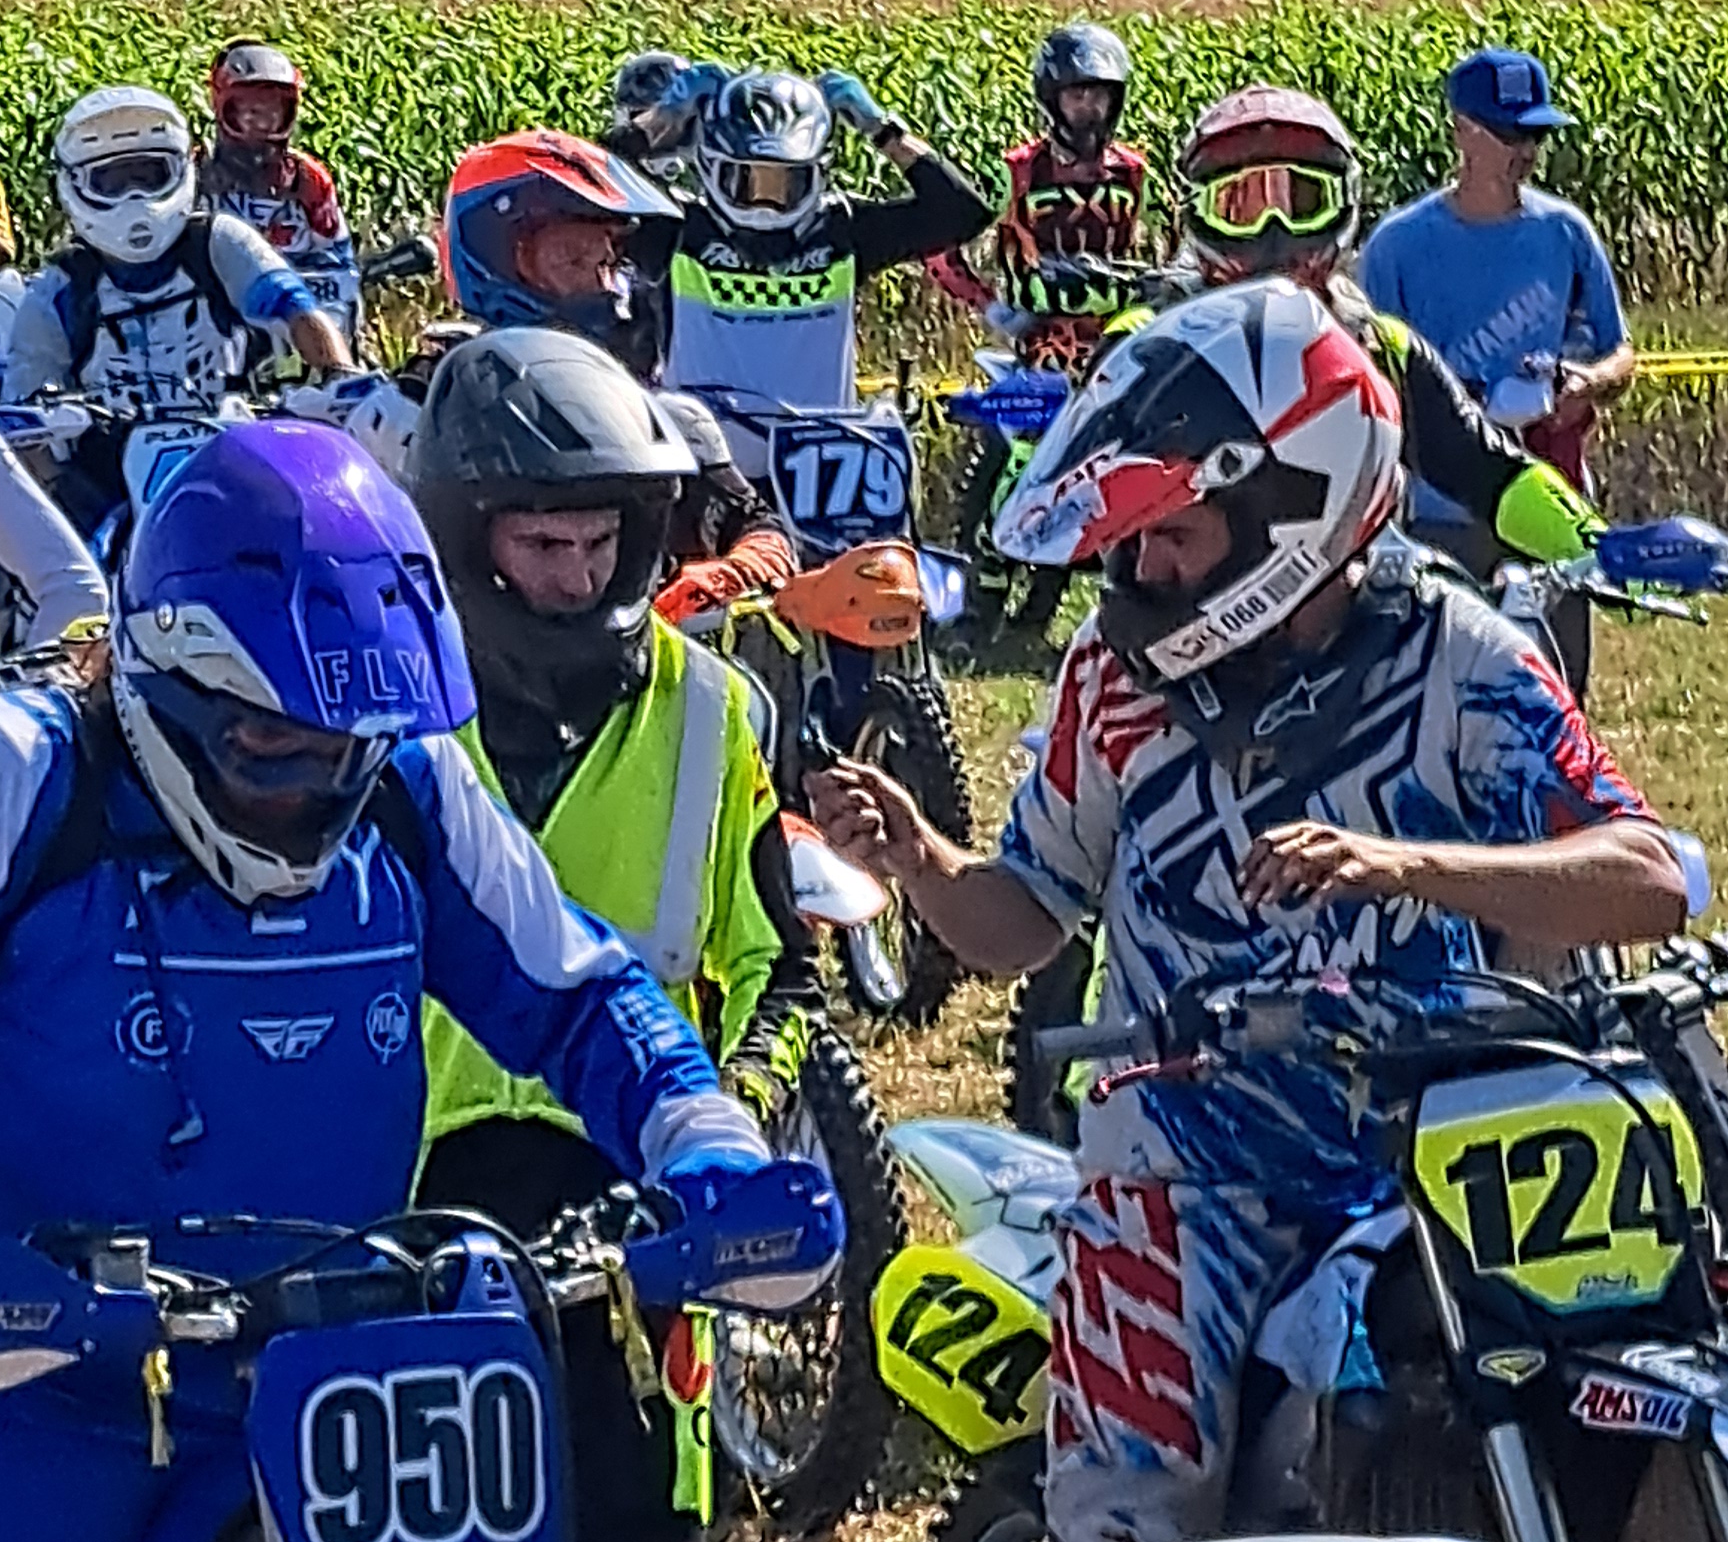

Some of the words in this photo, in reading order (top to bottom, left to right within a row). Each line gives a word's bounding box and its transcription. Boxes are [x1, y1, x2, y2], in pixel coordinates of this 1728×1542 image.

[783, 442, 907, 519] 179
[313, 648, 432, 705] FLY
[1444, 1123, 1690, 1270] 124
[887, 1271, 1053, 1426] 124
[1578, 1379, 1690, 1430] AMSOIL
